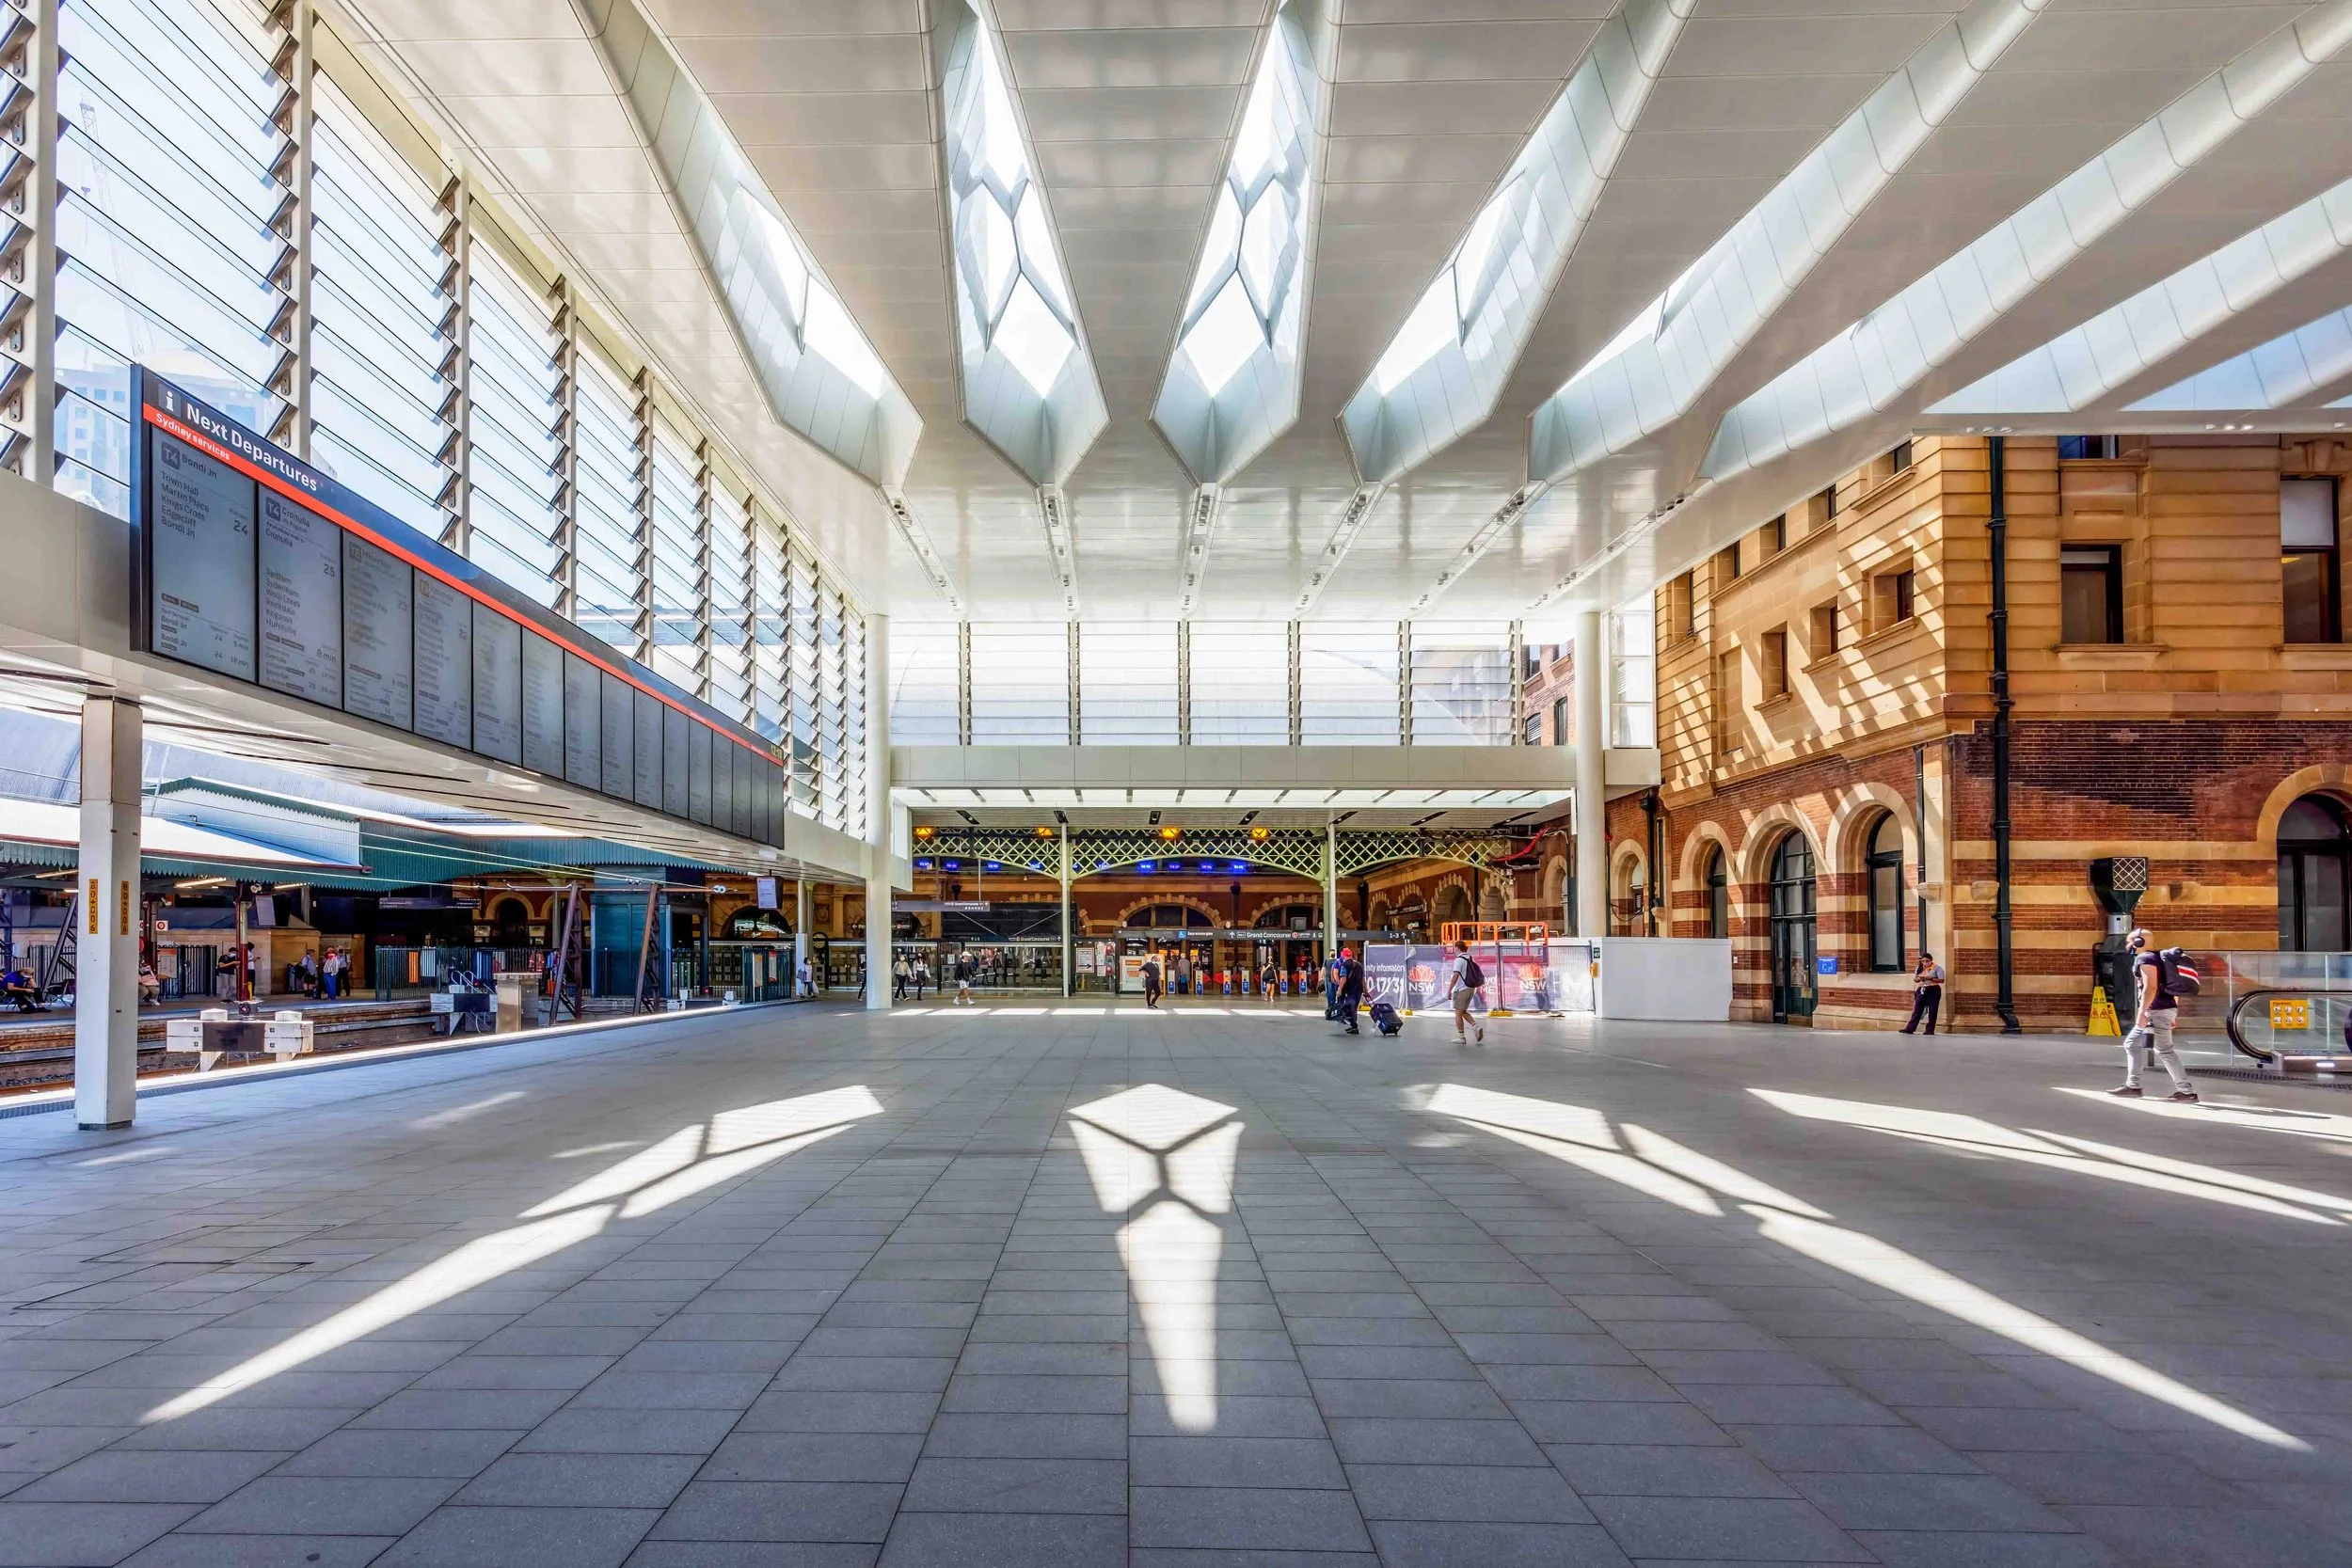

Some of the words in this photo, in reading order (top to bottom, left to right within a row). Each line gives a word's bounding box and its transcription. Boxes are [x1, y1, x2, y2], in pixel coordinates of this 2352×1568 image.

[156, 413, 192, 440] Sydney
[192, 435, 230, 460] services
[186, 403, 229, 441] Next
[231, 429, 317, 491] Departures
[182, 453, 207, 473] Bondi
[207, 468, 217, 479] Jn
[161, 470, 183, 487] Town
[183, 483, 199, 497] Hall
[161, 483, 188, 501] Martin
[233, 519, 248, 536] 24
[323, 563, 336, 578] 25
[1375, 963, 1405, 973] information
[1408, 982, 1435, 992] NSW
[1519, 980, 1547, 990] NSW
